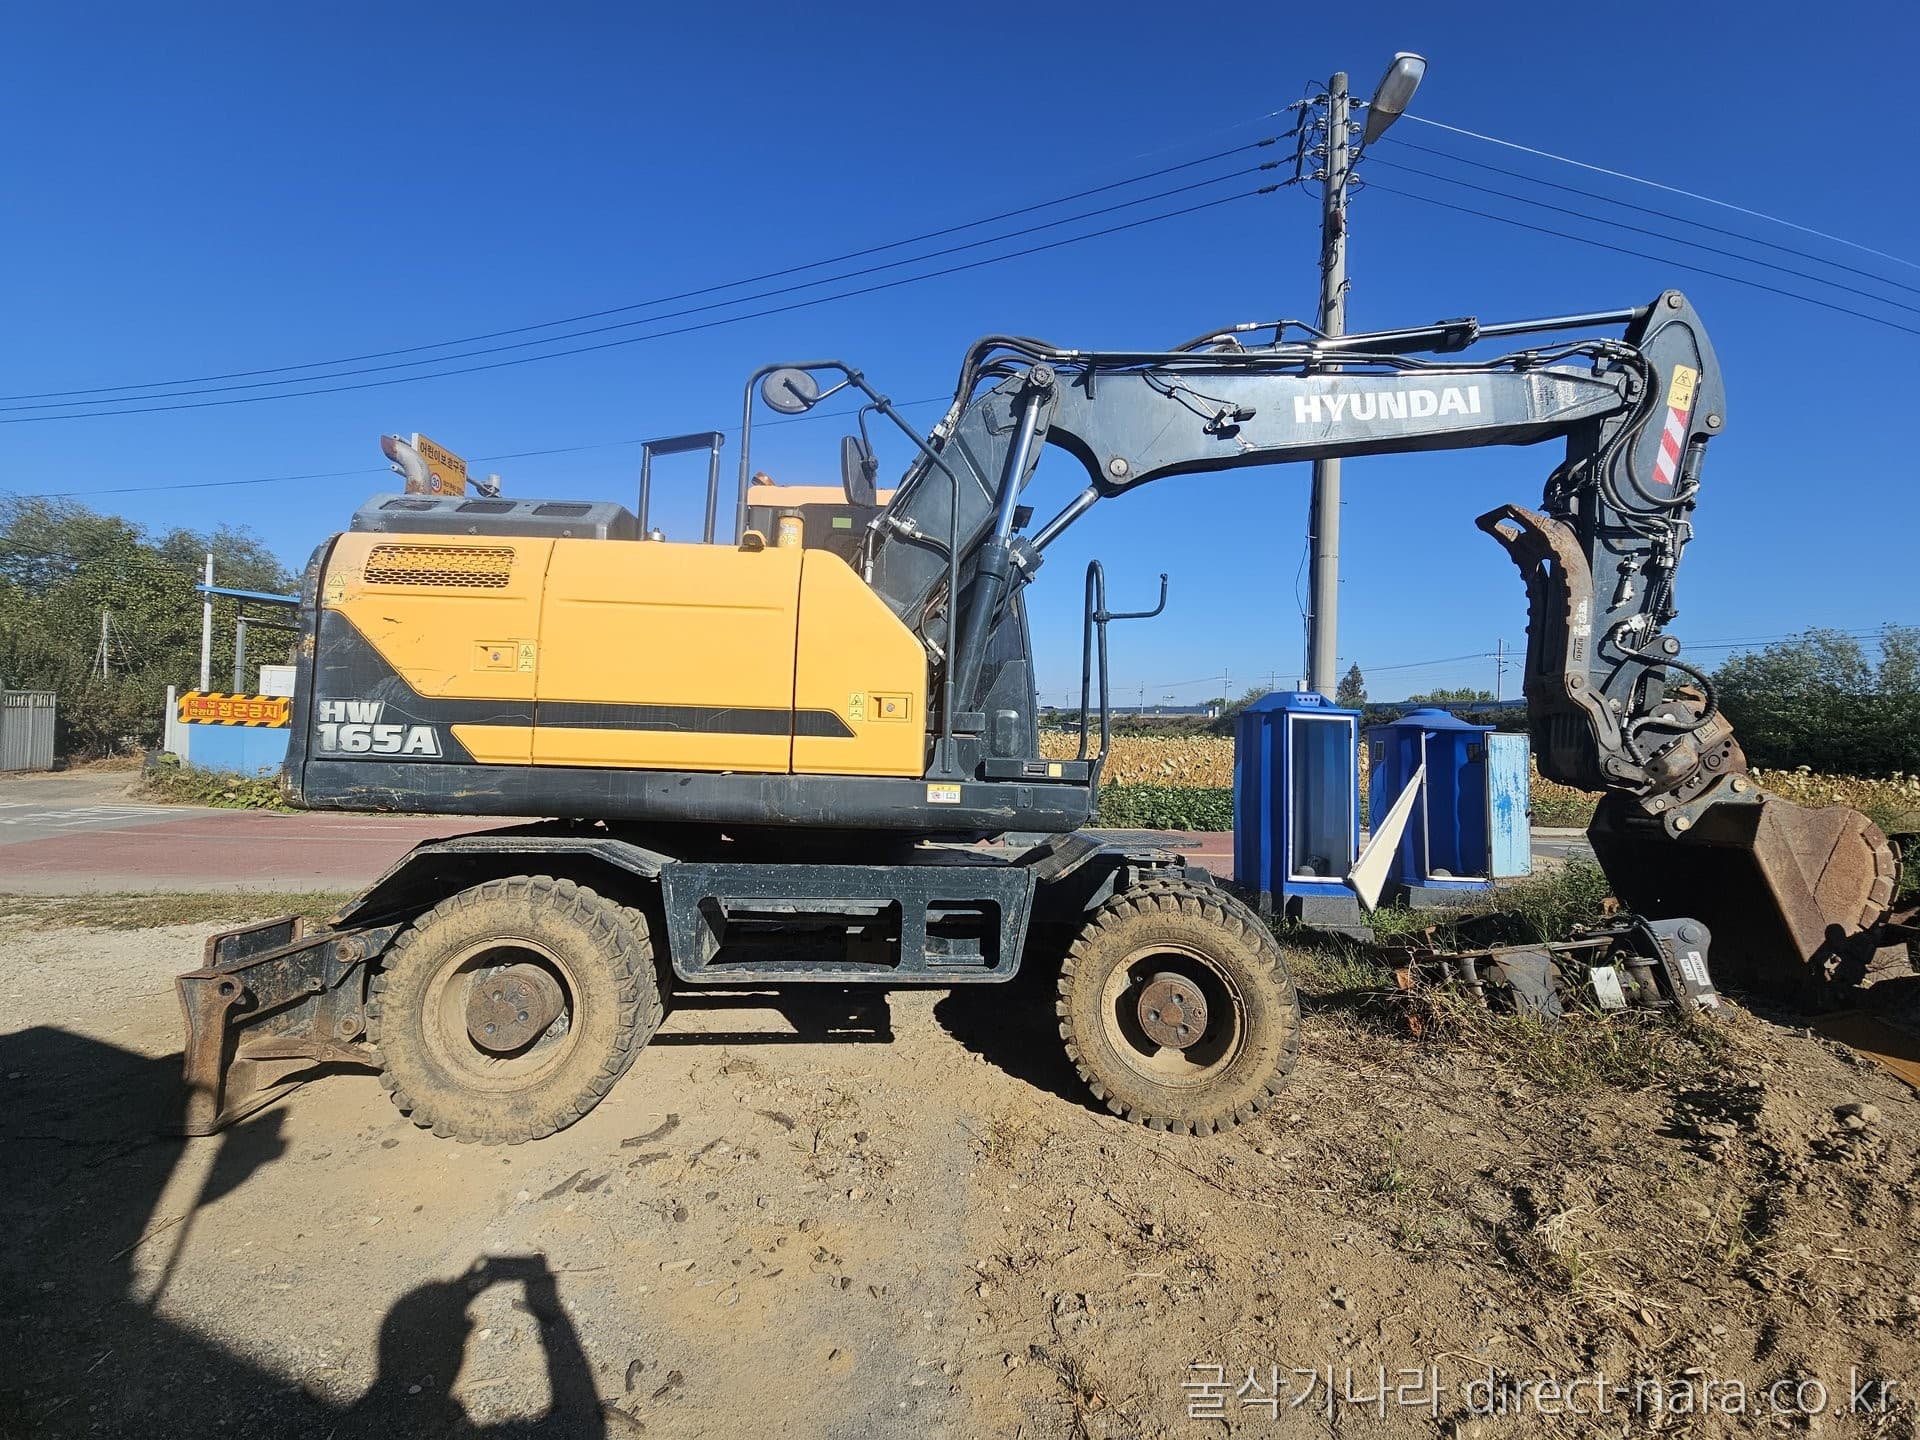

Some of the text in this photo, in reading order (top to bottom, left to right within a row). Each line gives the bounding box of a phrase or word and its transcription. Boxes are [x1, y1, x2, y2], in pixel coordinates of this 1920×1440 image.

[1294, 386, 1481, 423] HYUNDAI
[431, 477, 439, 488] 30
[218, 702, 278, 718] 접근금지
[320, 701, 381, 723] HW
[318, 724, 437, 754] 165A
